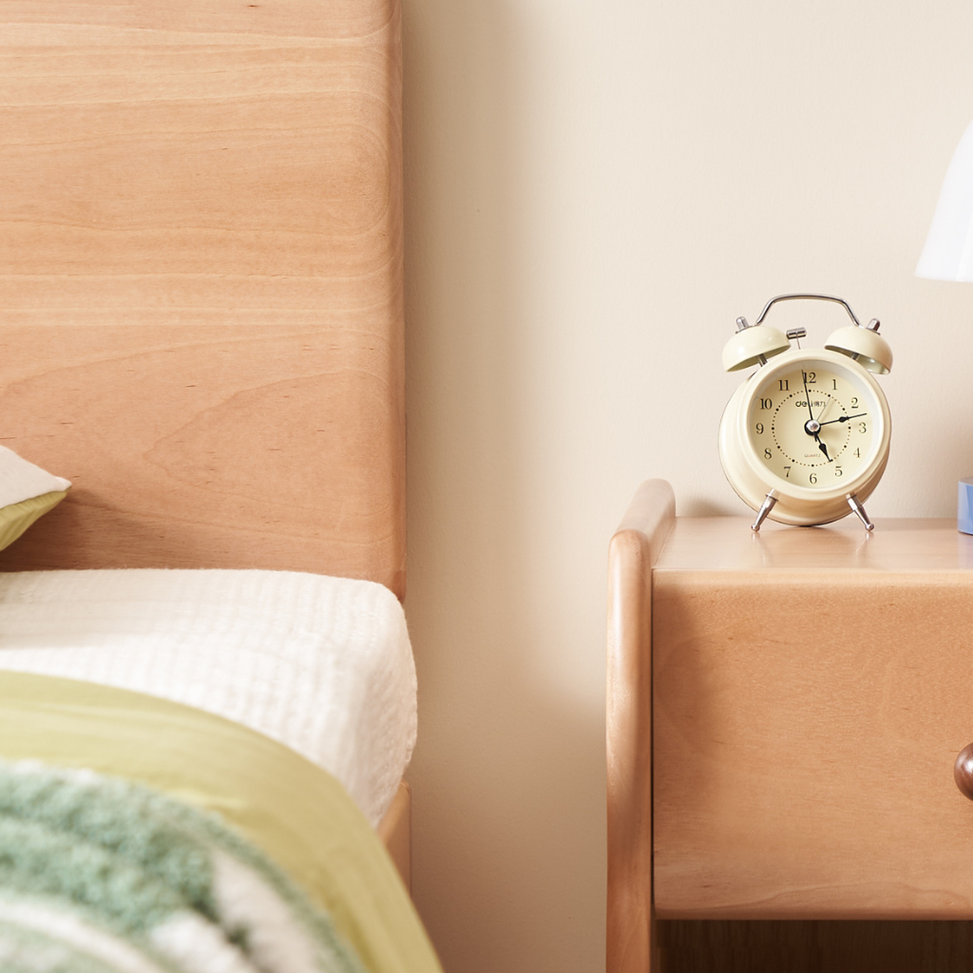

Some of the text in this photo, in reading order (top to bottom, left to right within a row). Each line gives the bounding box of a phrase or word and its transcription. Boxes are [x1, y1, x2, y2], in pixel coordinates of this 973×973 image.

[803, 372, 817, 384] 12
[778, 380, 790, 391] 11
[832, 379, 837, 390] 1
[759, 398, 773, 409] 10
[851, 398, 859, 409] 2
[756, 423, 764, 434] 9
[858, 423, 867, 434] 3
[764, 448, 772, 459] 8
[853, 448, 861, 458] 4
[784, 466, 791, 478] 7
[835, 466, 843, 477] 5
[809, 474, 818, 484] 6
